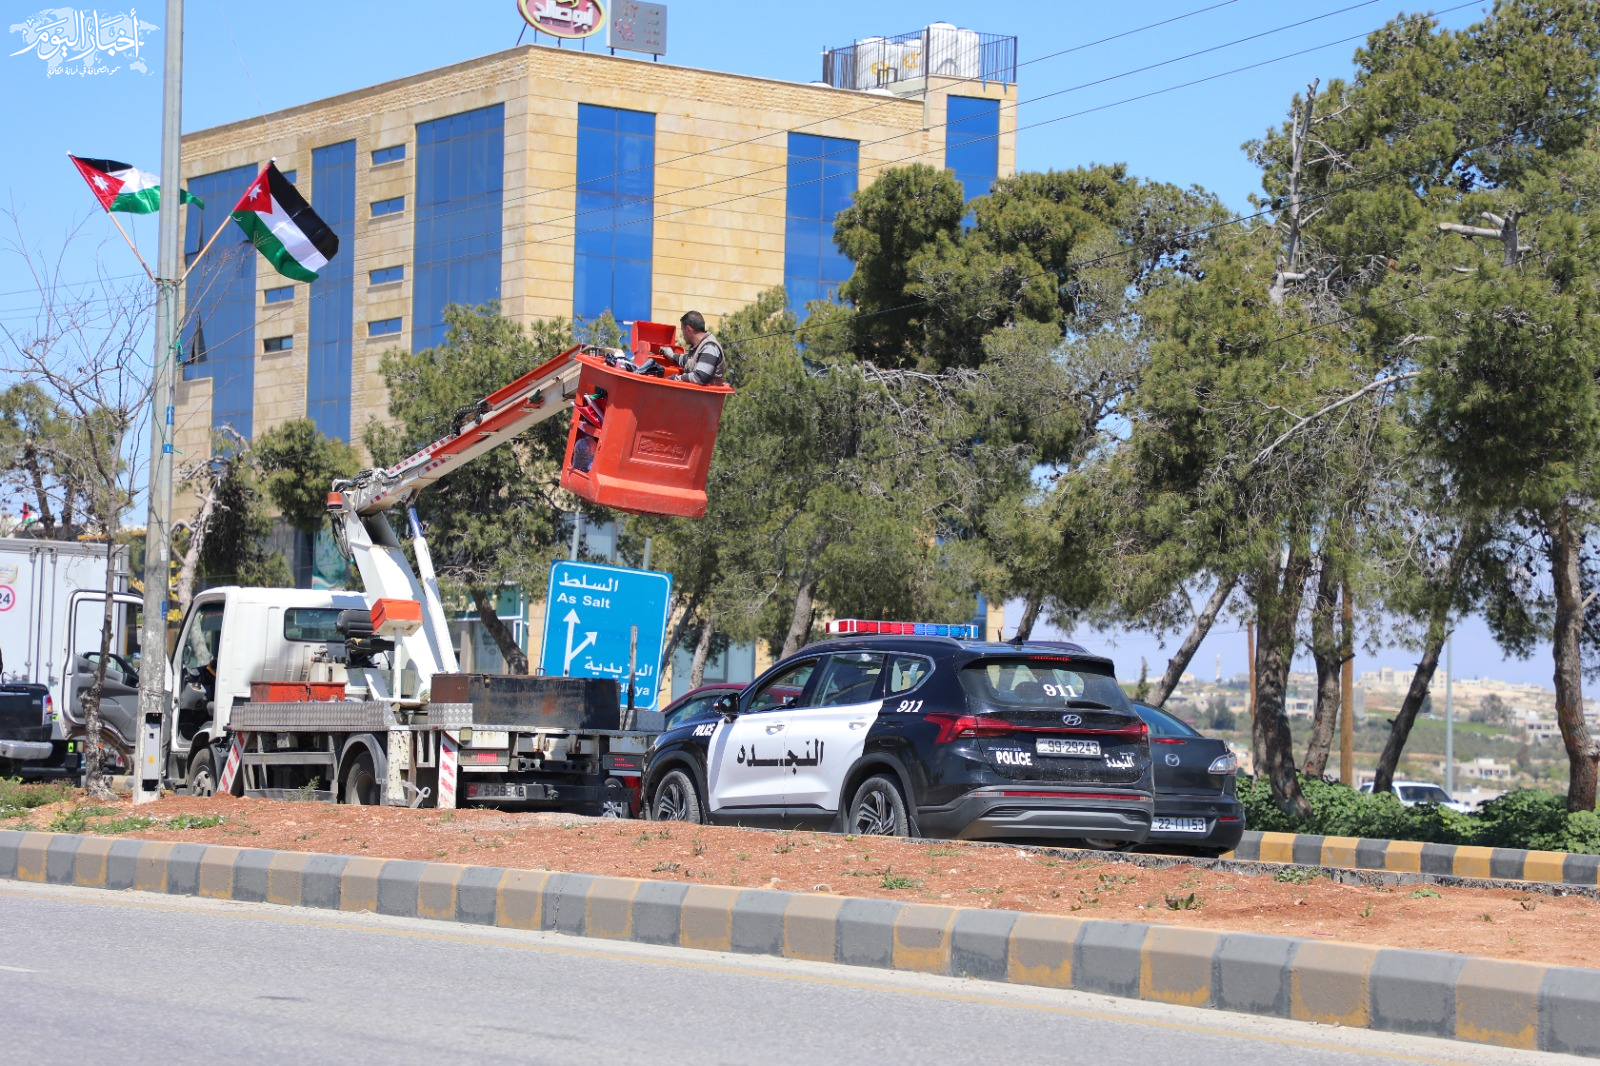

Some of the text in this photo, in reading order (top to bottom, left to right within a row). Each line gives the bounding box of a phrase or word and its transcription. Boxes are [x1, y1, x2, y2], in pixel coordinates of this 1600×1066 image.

[558, 572, 619, 593] السلط
[557, 592, 611, 609] As Salt
[1043, 683, 1079, 698] 911
[896, 700, 924, 713] 911
[995, 750, 1033, 766] POLICE
